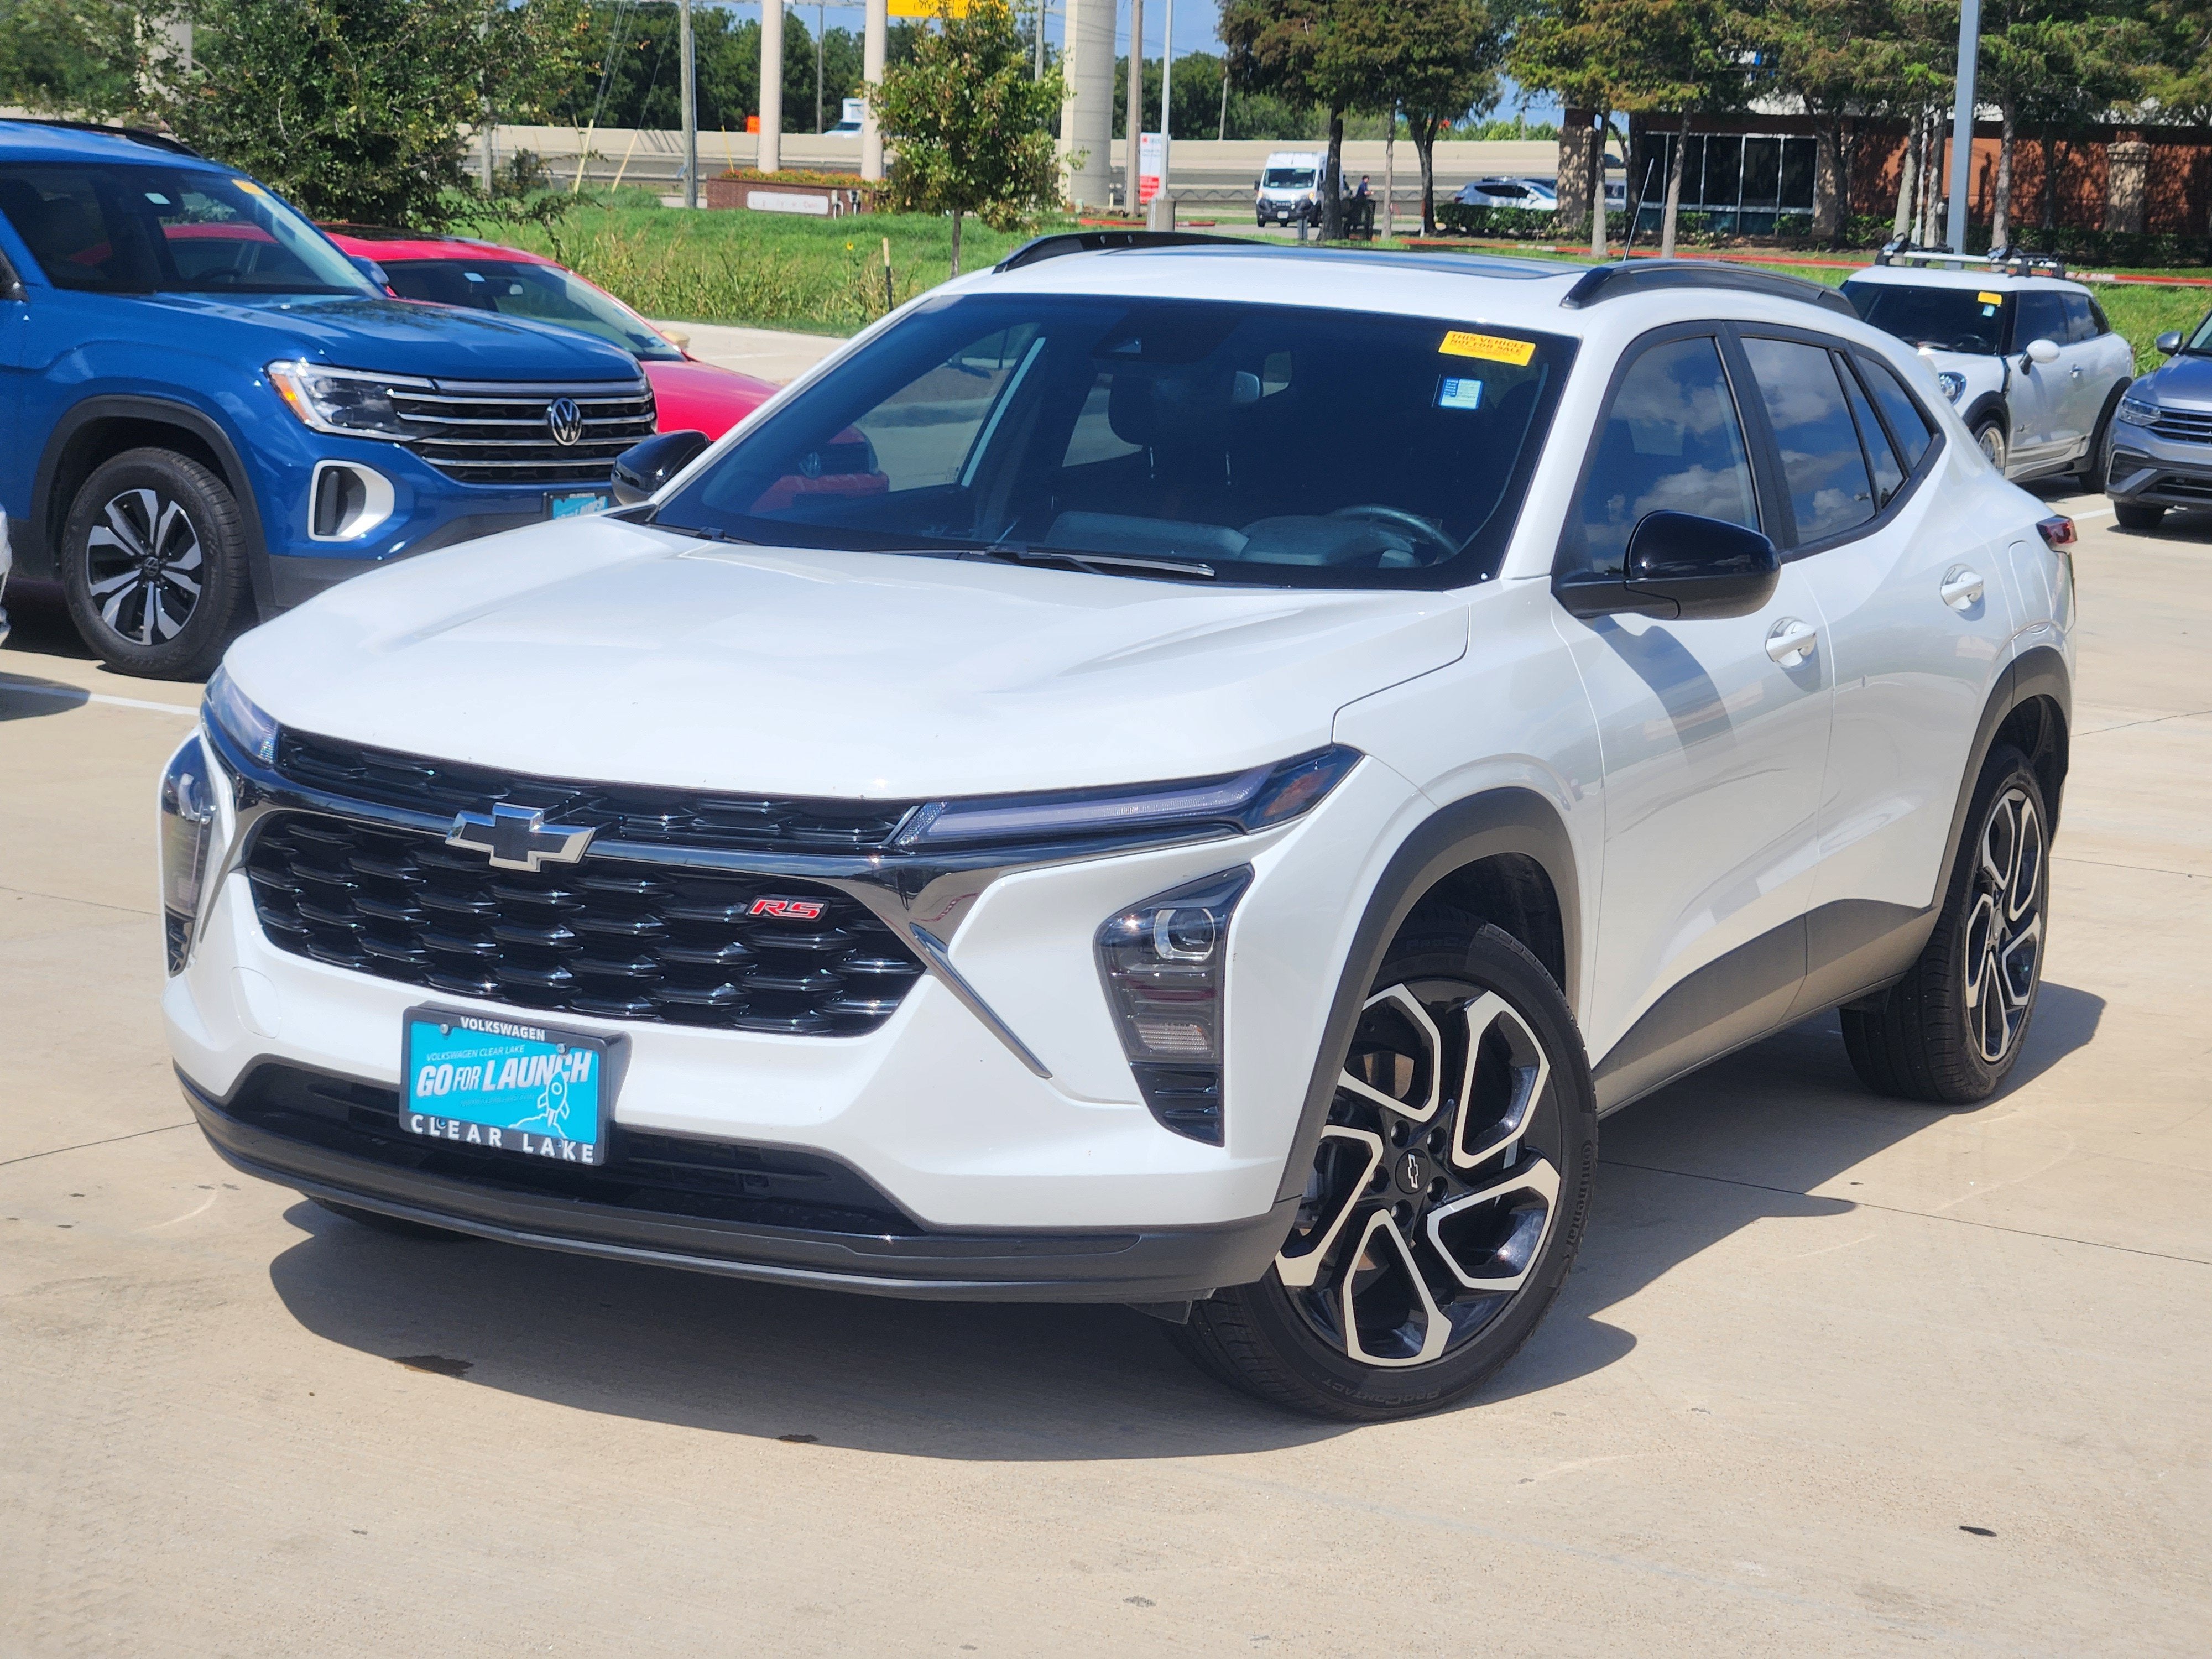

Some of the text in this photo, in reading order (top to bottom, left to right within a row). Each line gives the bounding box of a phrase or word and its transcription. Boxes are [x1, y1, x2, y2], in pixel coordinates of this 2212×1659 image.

[1480, 337, 1527, 348] VEHICLE
[749, 899, 824, 919] RS
[460, 1016, 545, 1041] VOLKSWAGEN
[426, 1044, 525, 1062] VOLKSWAGEN CLEAR LAKE
[416, 1050, 593, 1097] GO FOR LAUNCH
[410, 1114, 594, 1164] CLEAR LAKE
